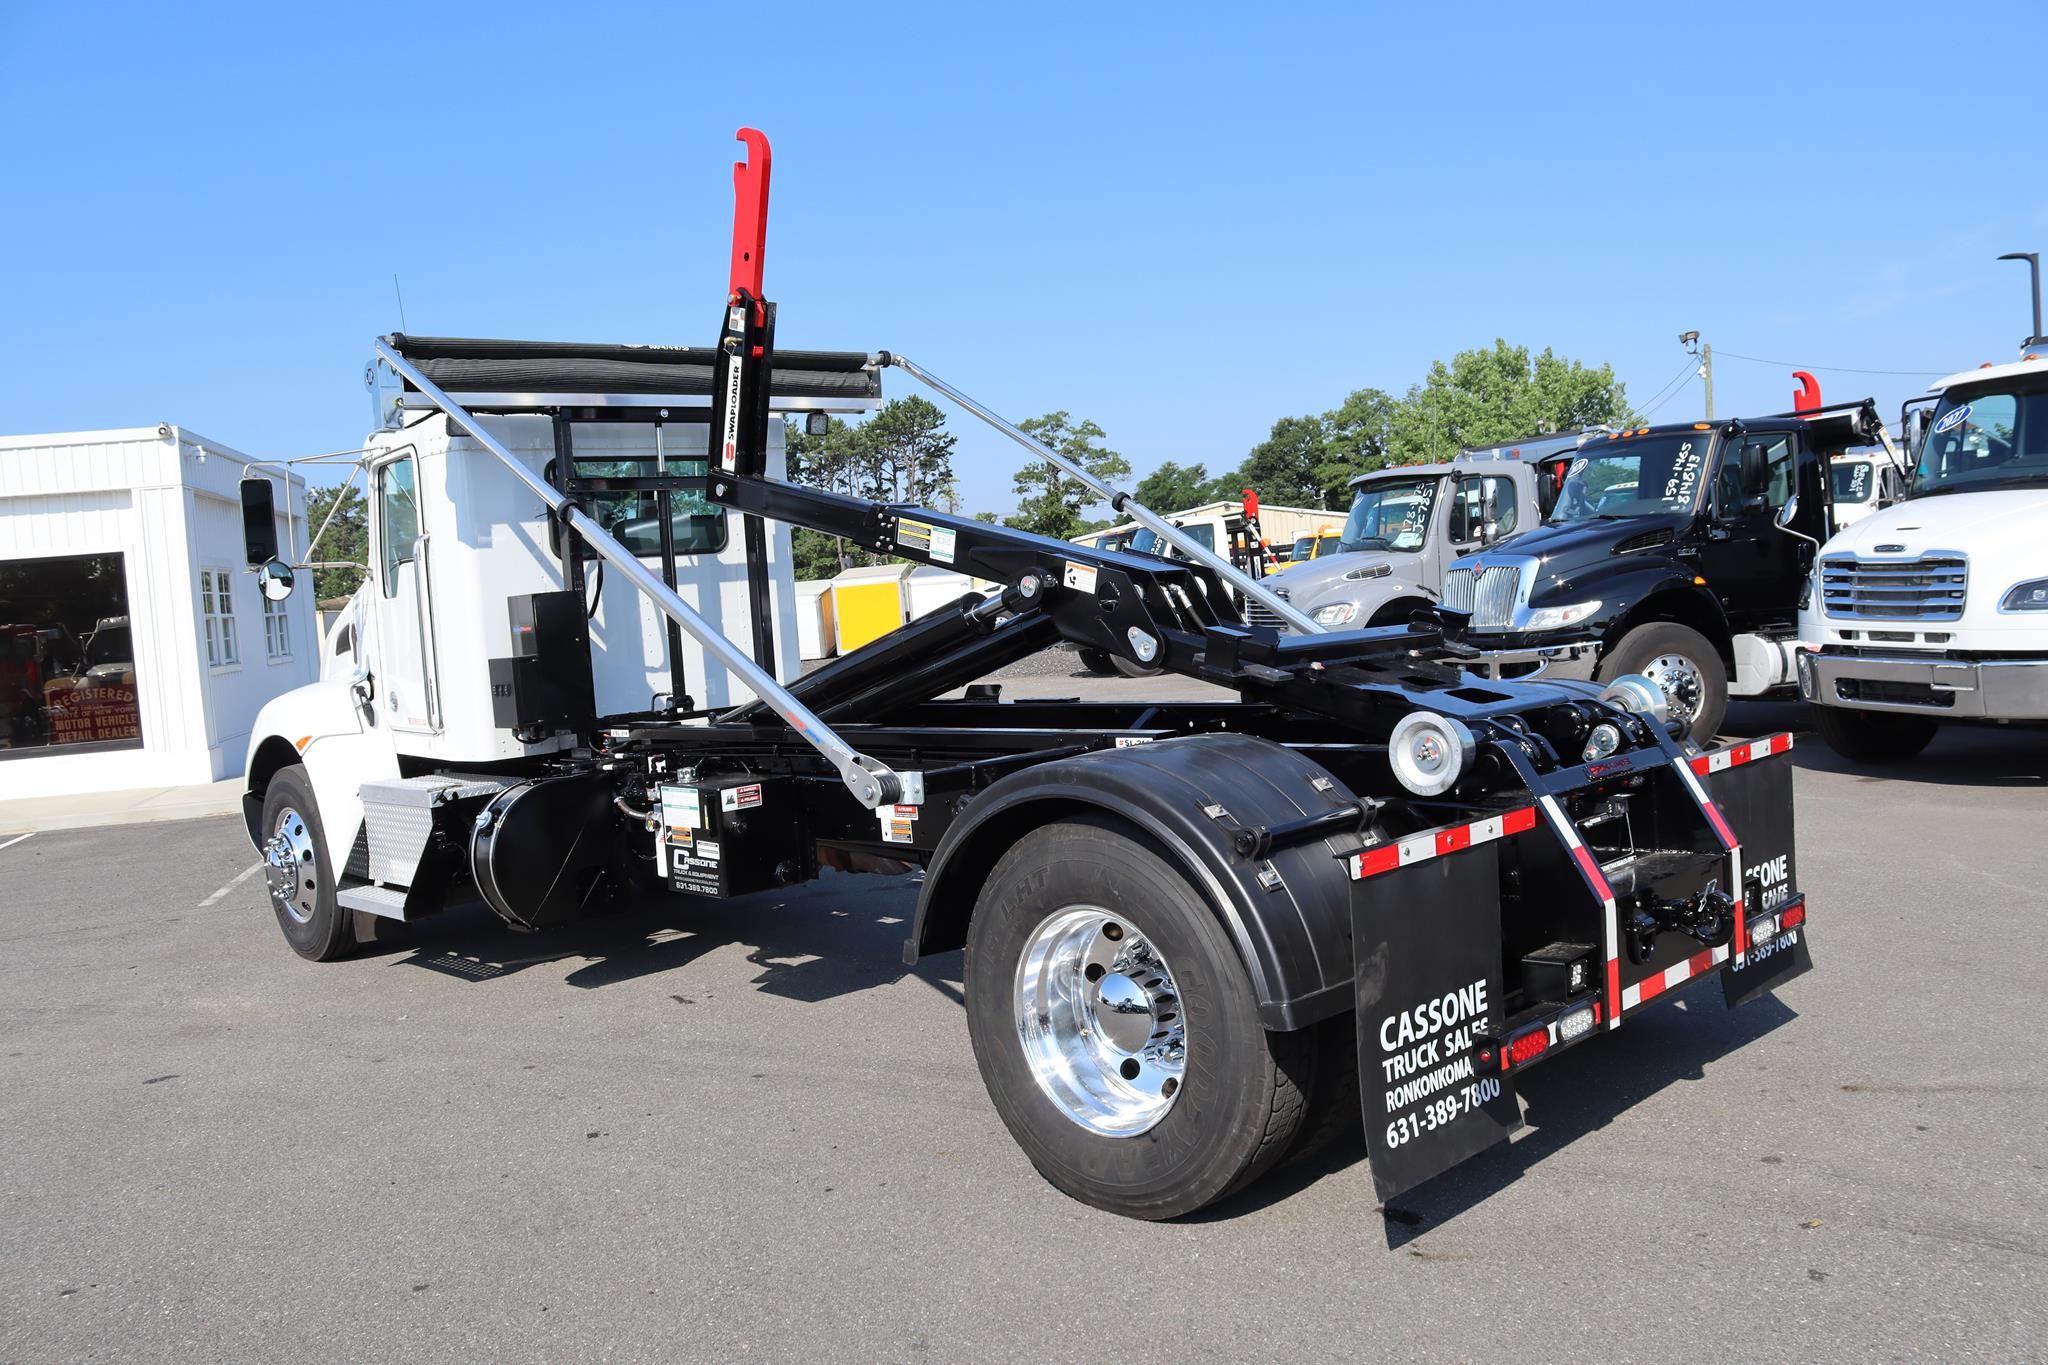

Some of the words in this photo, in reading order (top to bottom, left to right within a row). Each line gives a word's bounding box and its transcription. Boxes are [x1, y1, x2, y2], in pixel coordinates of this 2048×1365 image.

[728, 365, 740, 440] SWAPLOADER
[55, 718, 91, 731] MOTOR
[96, 713, 137, 728] VEHICLE
[58, 729, 95, 743] RETAIL
[98, 725, 138, 739] DEALER
[1380, 979, 1488, 1051] CASSONE
[1382, 1039, 1439, 1083] TRUCK
[1386, 1079, 1500, 1148] 631-389-7800
